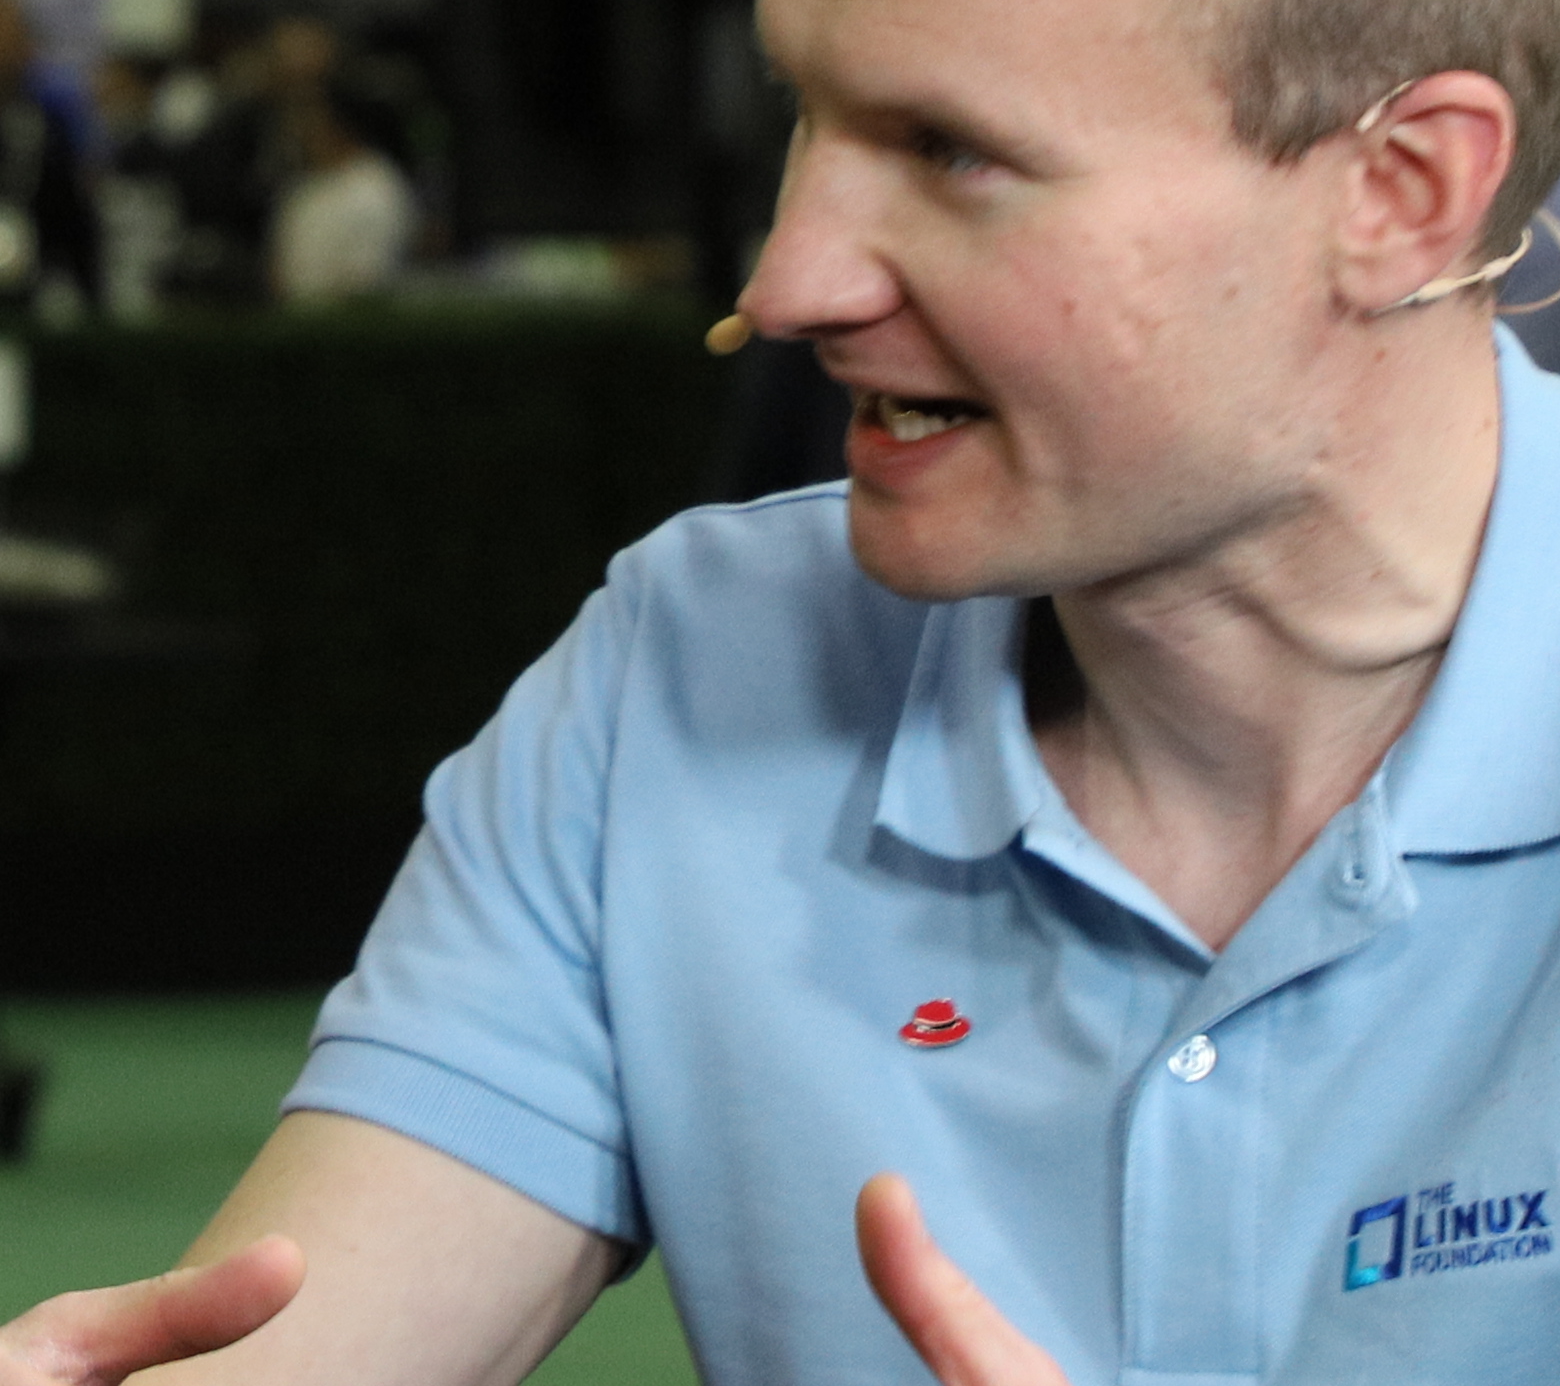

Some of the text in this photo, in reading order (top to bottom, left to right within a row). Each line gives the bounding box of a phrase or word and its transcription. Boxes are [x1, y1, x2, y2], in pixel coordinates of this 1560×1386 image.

[1416, 1181, 1455, 1209] THE
[1414, 1189, 1552, 1250] LINUX
[1410, 1230, 1554, 1275] FOUNDATION
